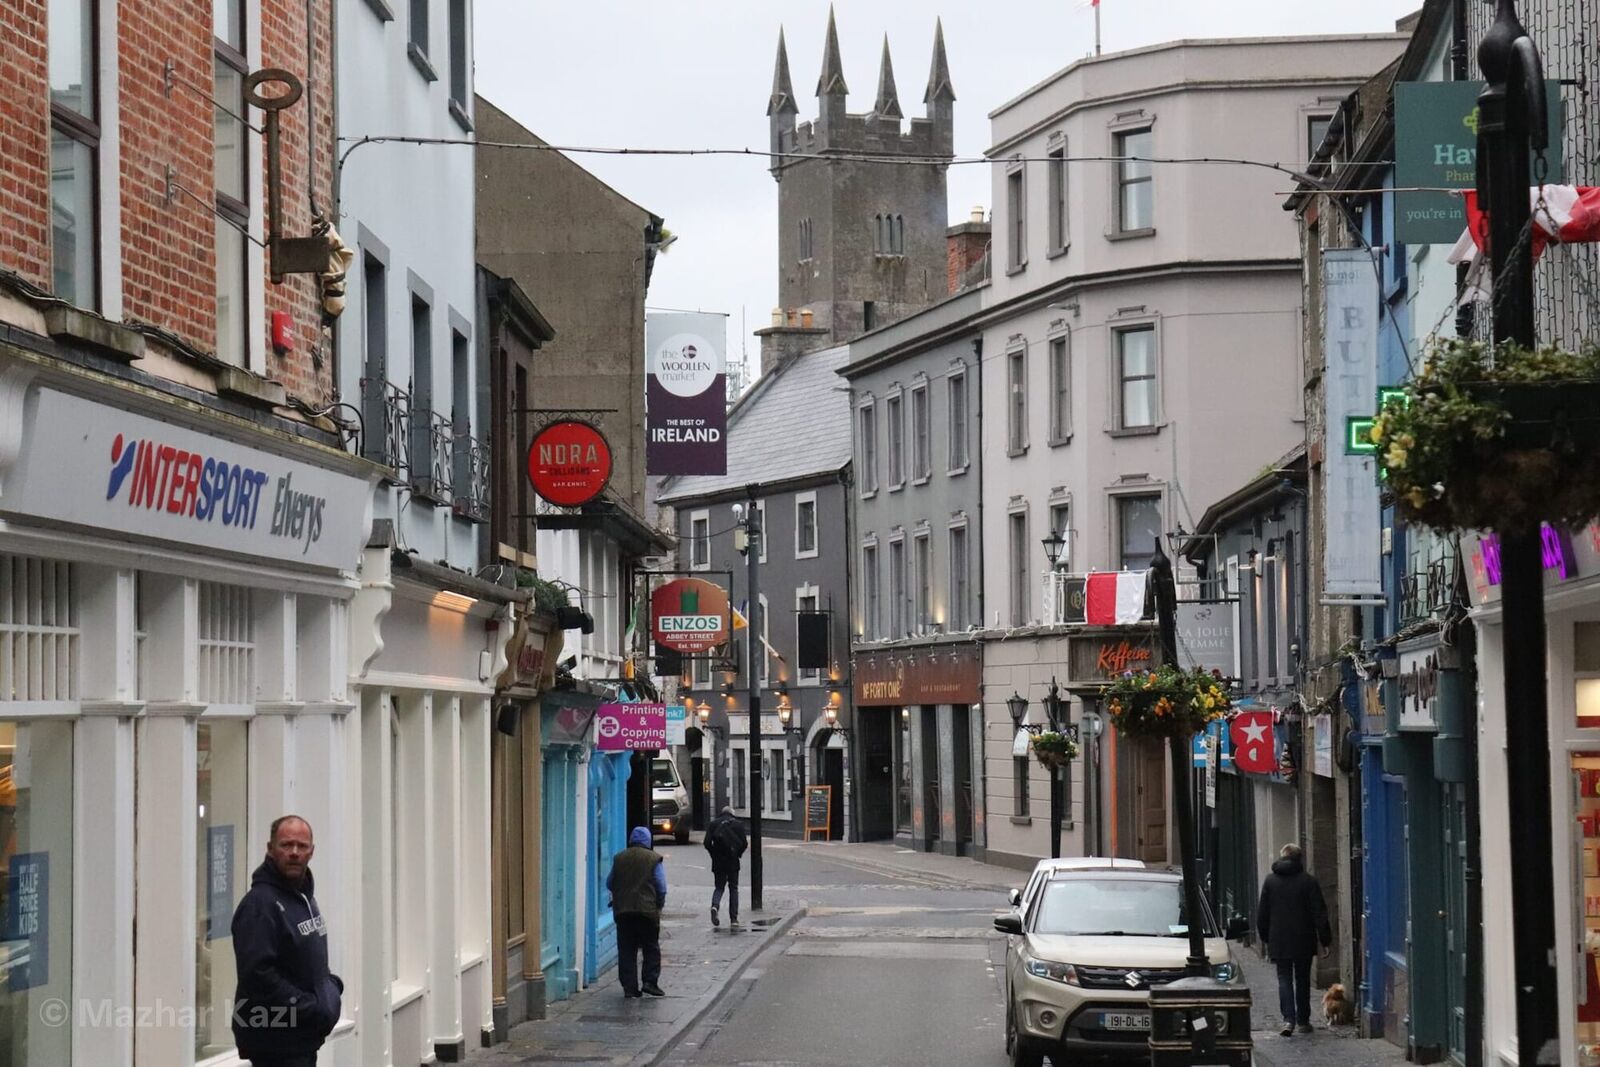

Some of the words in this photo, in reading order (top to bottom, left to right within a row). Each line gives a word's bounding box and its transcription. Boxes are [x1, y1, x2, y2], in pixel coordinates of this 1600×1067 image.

[1446, 169, 1476, 181] Phar
[1407, 207, 1446, 222] you're
[1449, 207, 1462, 218] in
[662, 350, 679, 359] the
[661, 361, 710, 371] WOOLLEN
[662, 371, 695, 381] market
[652, 428, 720, 442] IRELAND
[539, 443, 598, 465] NORA
[128, 439, 268, 530] INTERSPORT
[270, 471, 326, 554] Elverys
[661, 617, 718, 630] ENZOS
[1197, 626, 1231, 638] JOLIE
[870, 681, 887, 698] FORTY
[887, 680, 900, 698] ONE
[622, 705, 665, 716] Printing
[639, 717, 647, 726] &
[621, 728, 666, 738] Copying
[625, 739, 662, 748] Centre
[19, 912, 39, 936] KIDS
